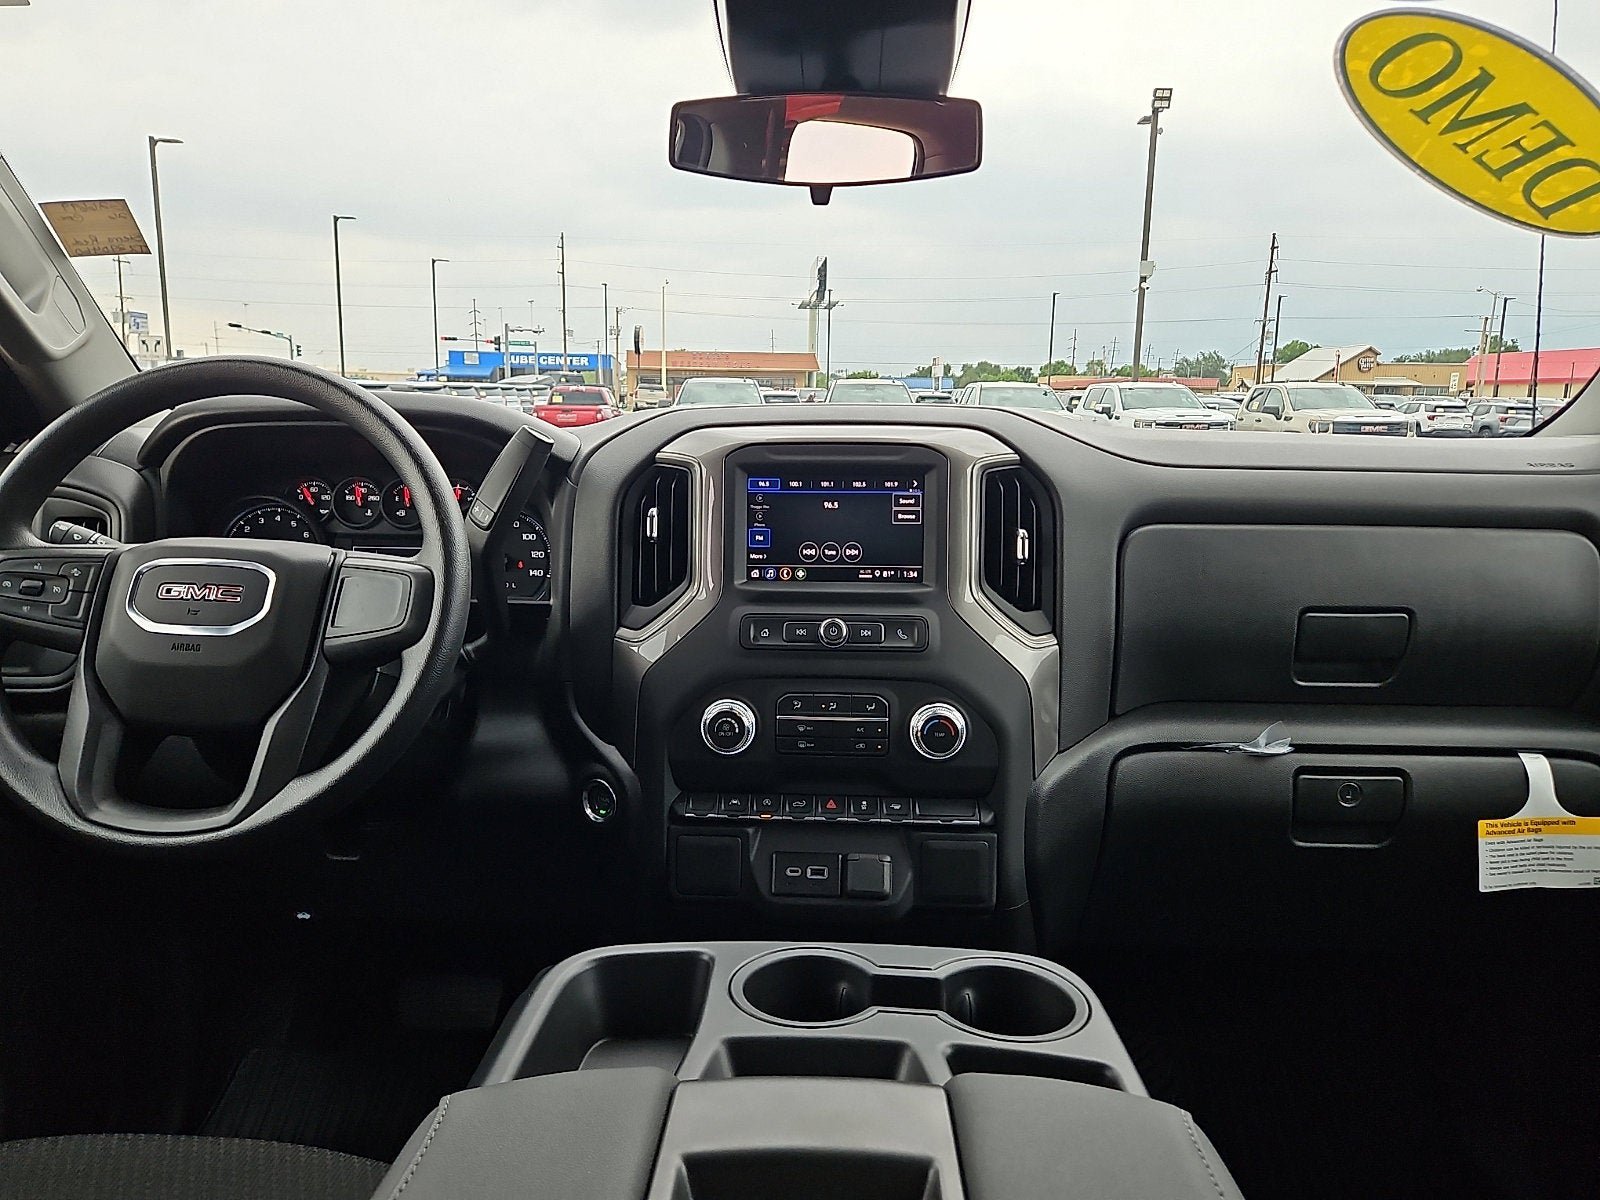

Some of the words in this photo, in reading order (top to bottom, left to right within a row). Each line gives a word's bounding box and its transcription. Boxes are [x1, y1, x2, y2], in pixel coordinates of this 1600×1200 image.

[539, 355, 589, 366] CENTER
[1360, 425, 1388, 433] GMC
[823, 501, 839, 509] 96.5
[244, 525, 251, 533] 2
[522, 533, 537, 541] 100
[531, 550, 545, 559] 120
[529, 569, 544, 577] 140
[903, 570, 918, 578] 1:34
[157, 582, 245, 602] GMC
[171, 642, 202, 653] AIRBAG
[1530, 819, 1560, 827] Equipped
